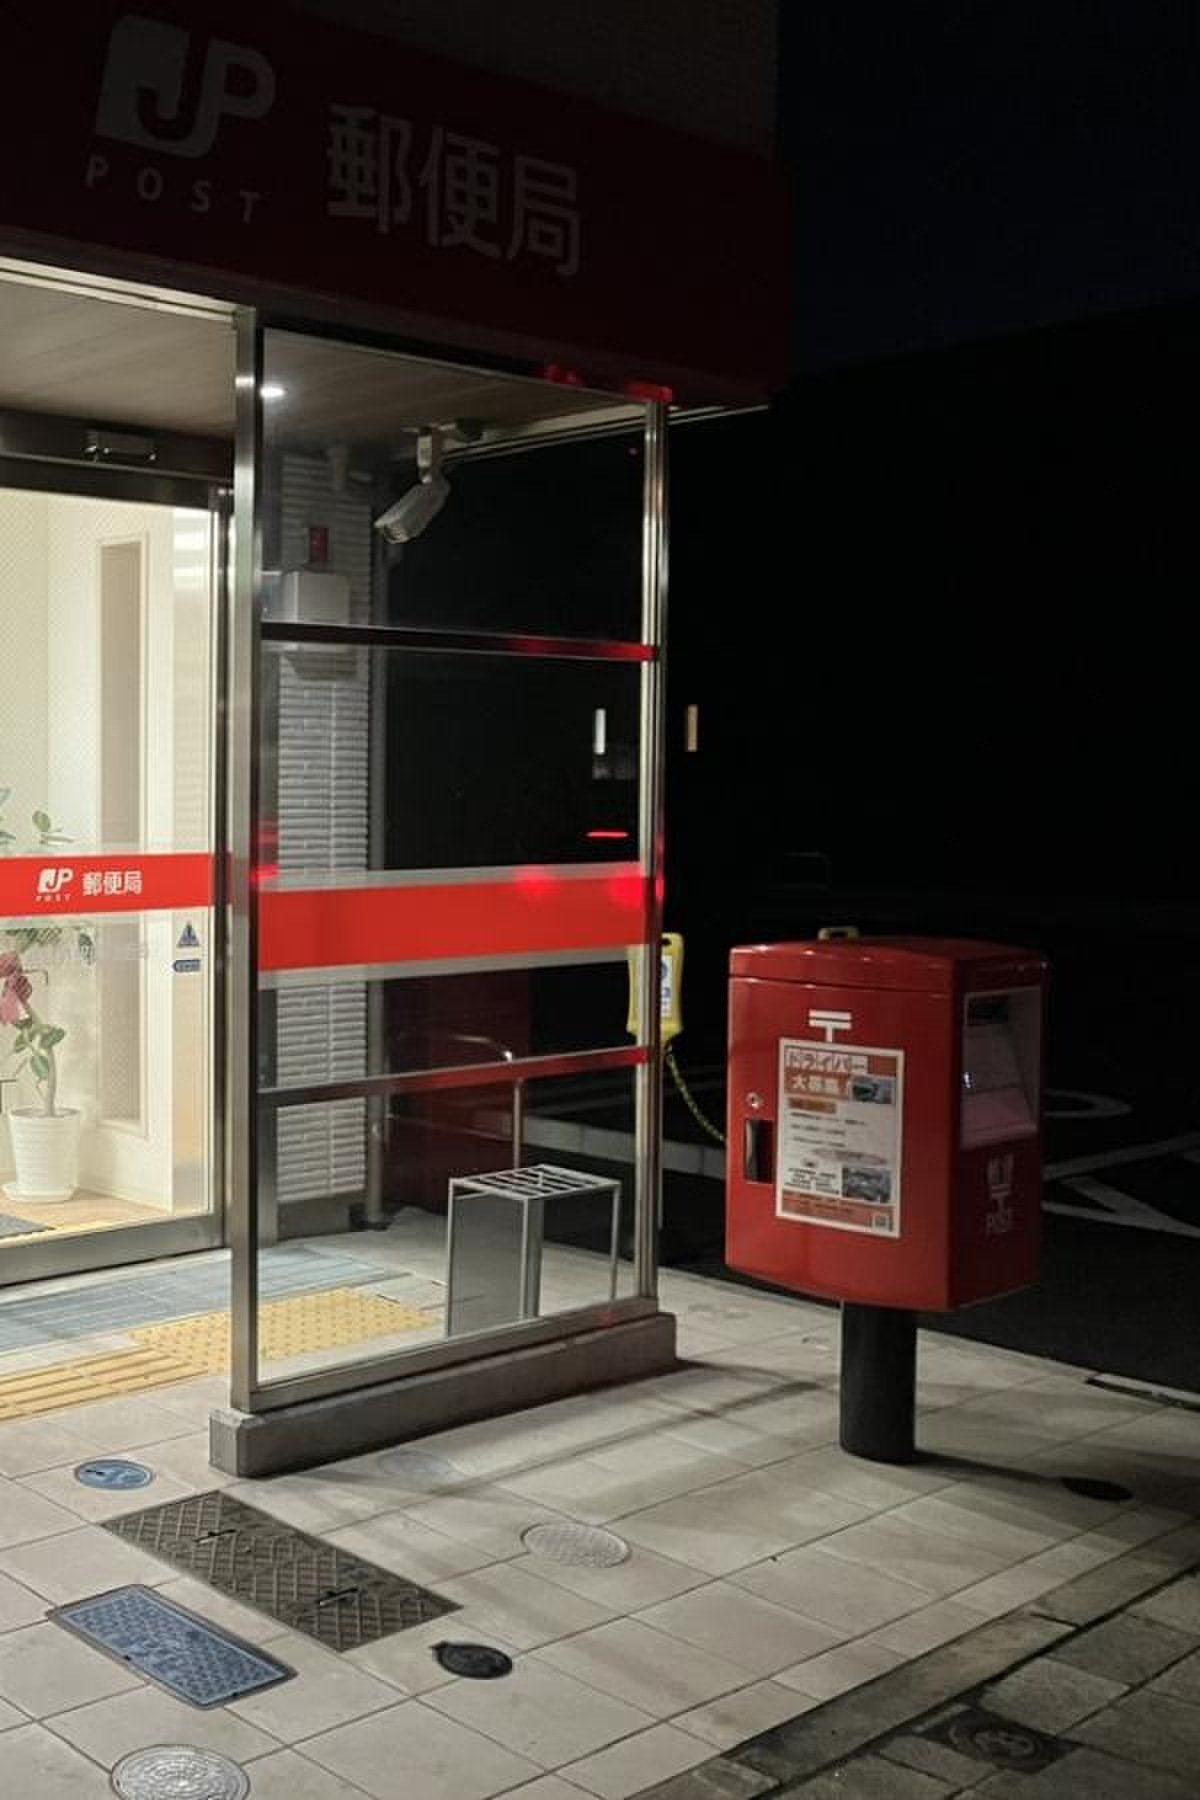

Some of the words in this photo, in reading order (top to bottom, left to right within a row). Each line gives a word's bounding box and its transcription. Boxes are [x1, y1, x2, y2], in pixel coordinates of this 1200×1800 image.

[96, 14, 276, 160] JP
[84, 154, 262, 225] POST
[325, 101, 584, 277] 郵便局
[82, 870, 142, 896] 郵便局
[785, 1049, 865, 1072] ドライバー
